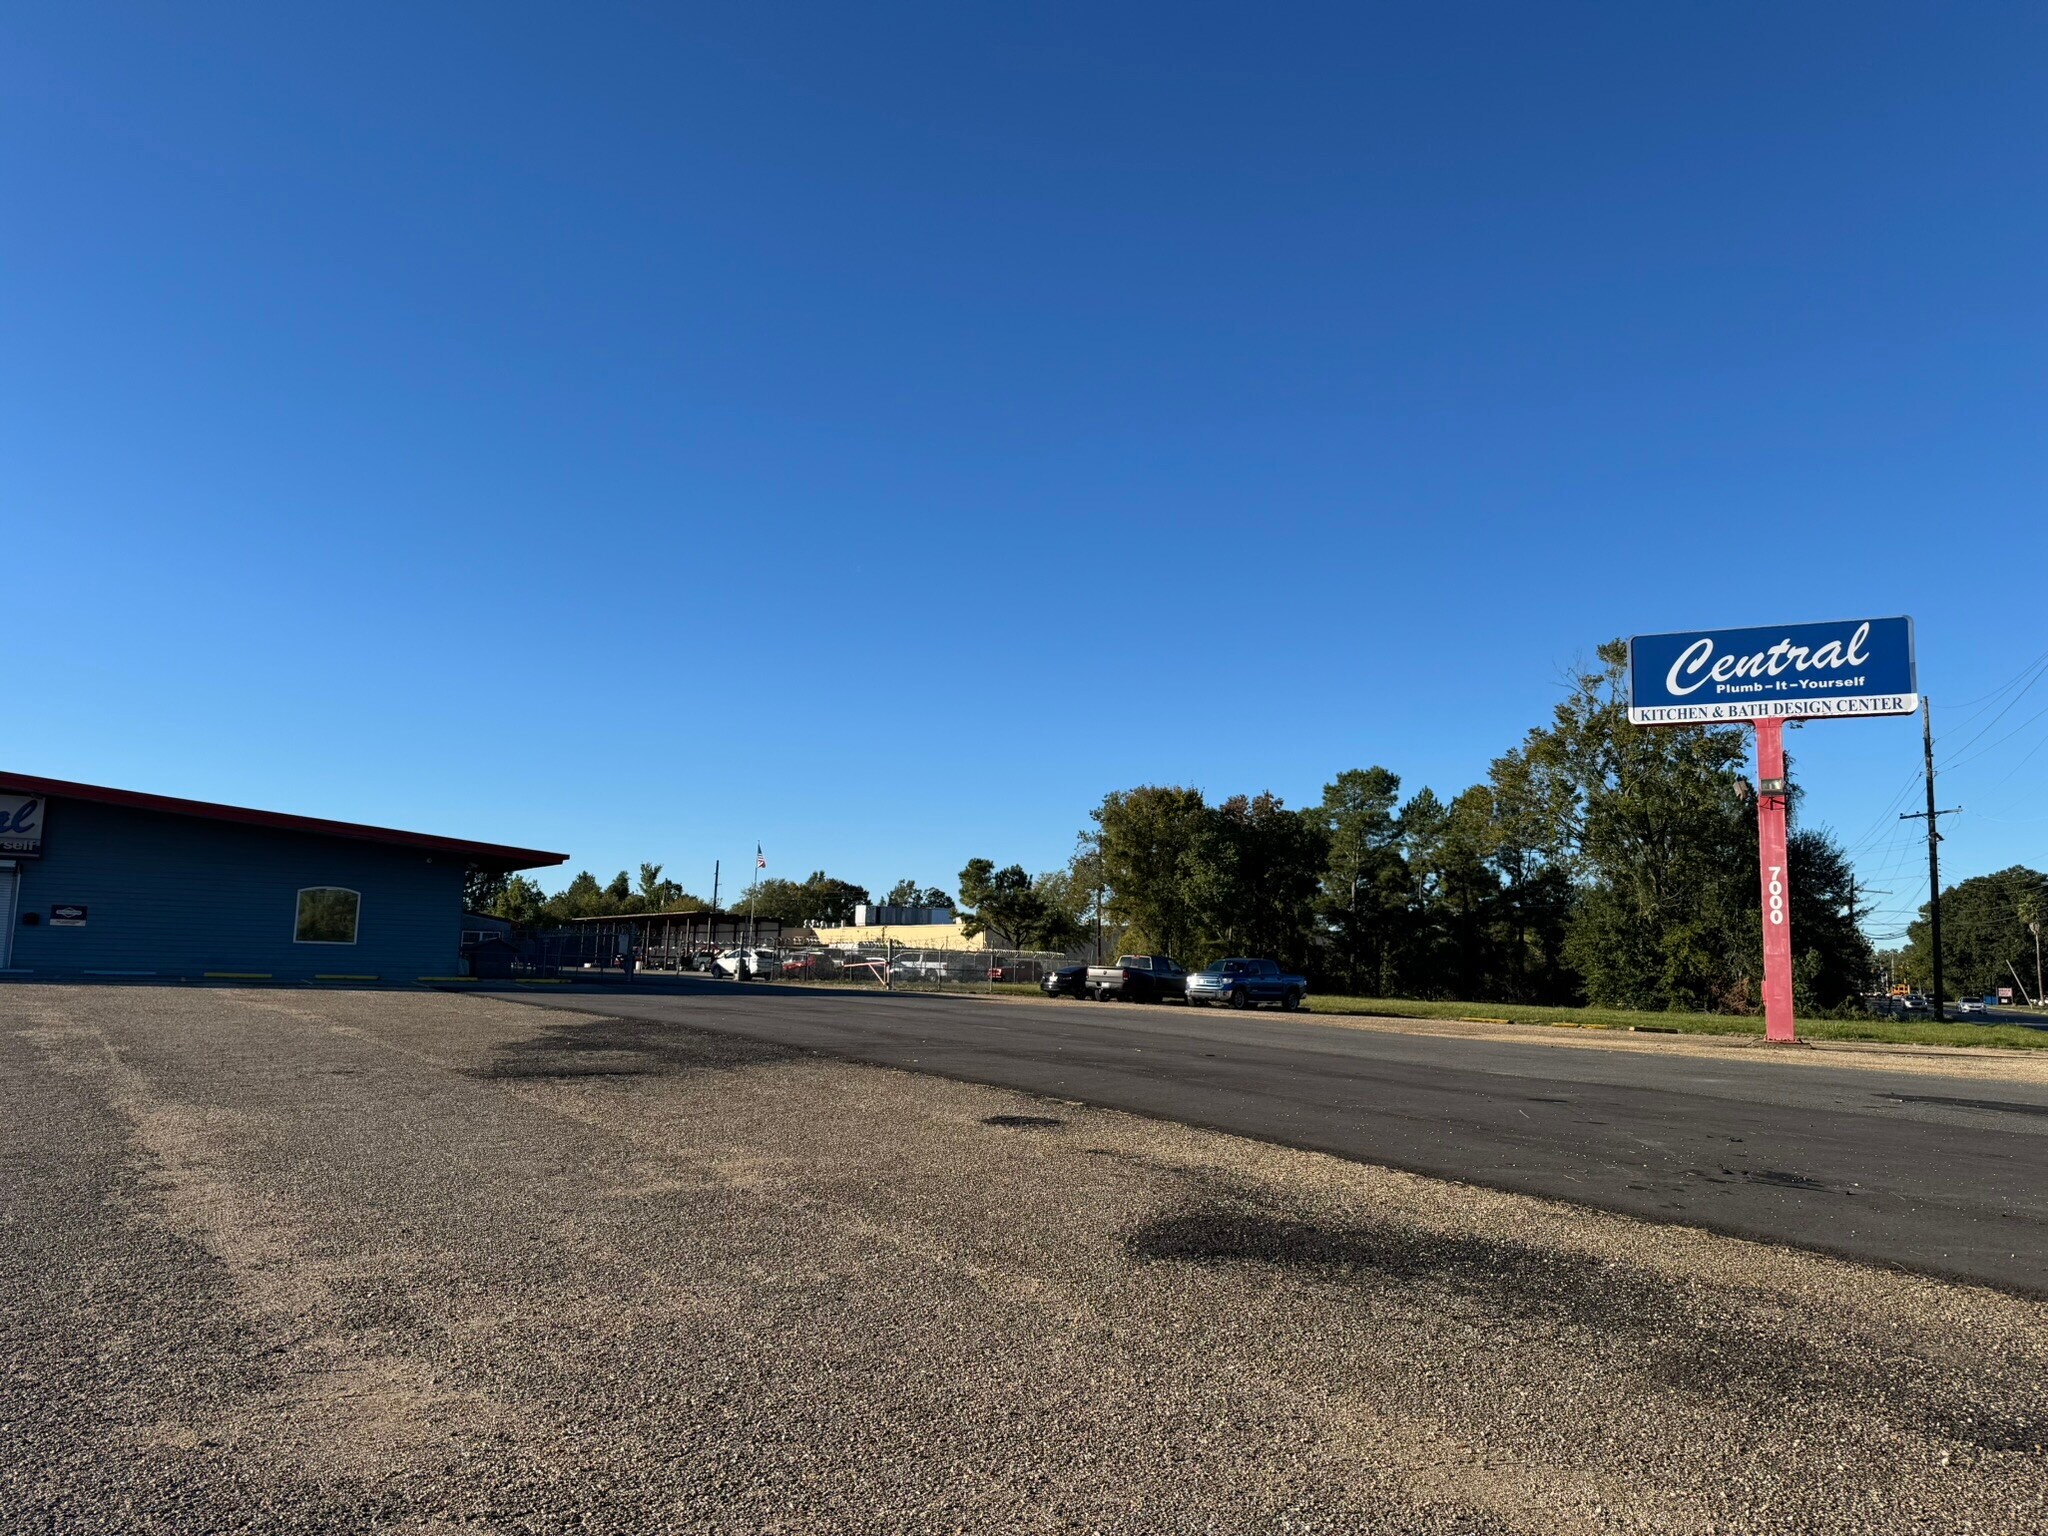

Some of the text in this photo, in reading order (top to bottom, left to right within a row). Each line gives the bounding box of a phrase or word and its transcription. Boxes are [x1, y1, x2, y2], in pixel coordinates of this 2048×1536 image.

[1666, 621, 1869, 696] Central
[1716, 676, 1866, 694] Plumb-It-Yourself
[1640, 697, 1903, 722] KITCHEN & BATH DESIGN CENTER
[0, 840, 36, 851] self
[1768, 866, 1783, 925] 7000
